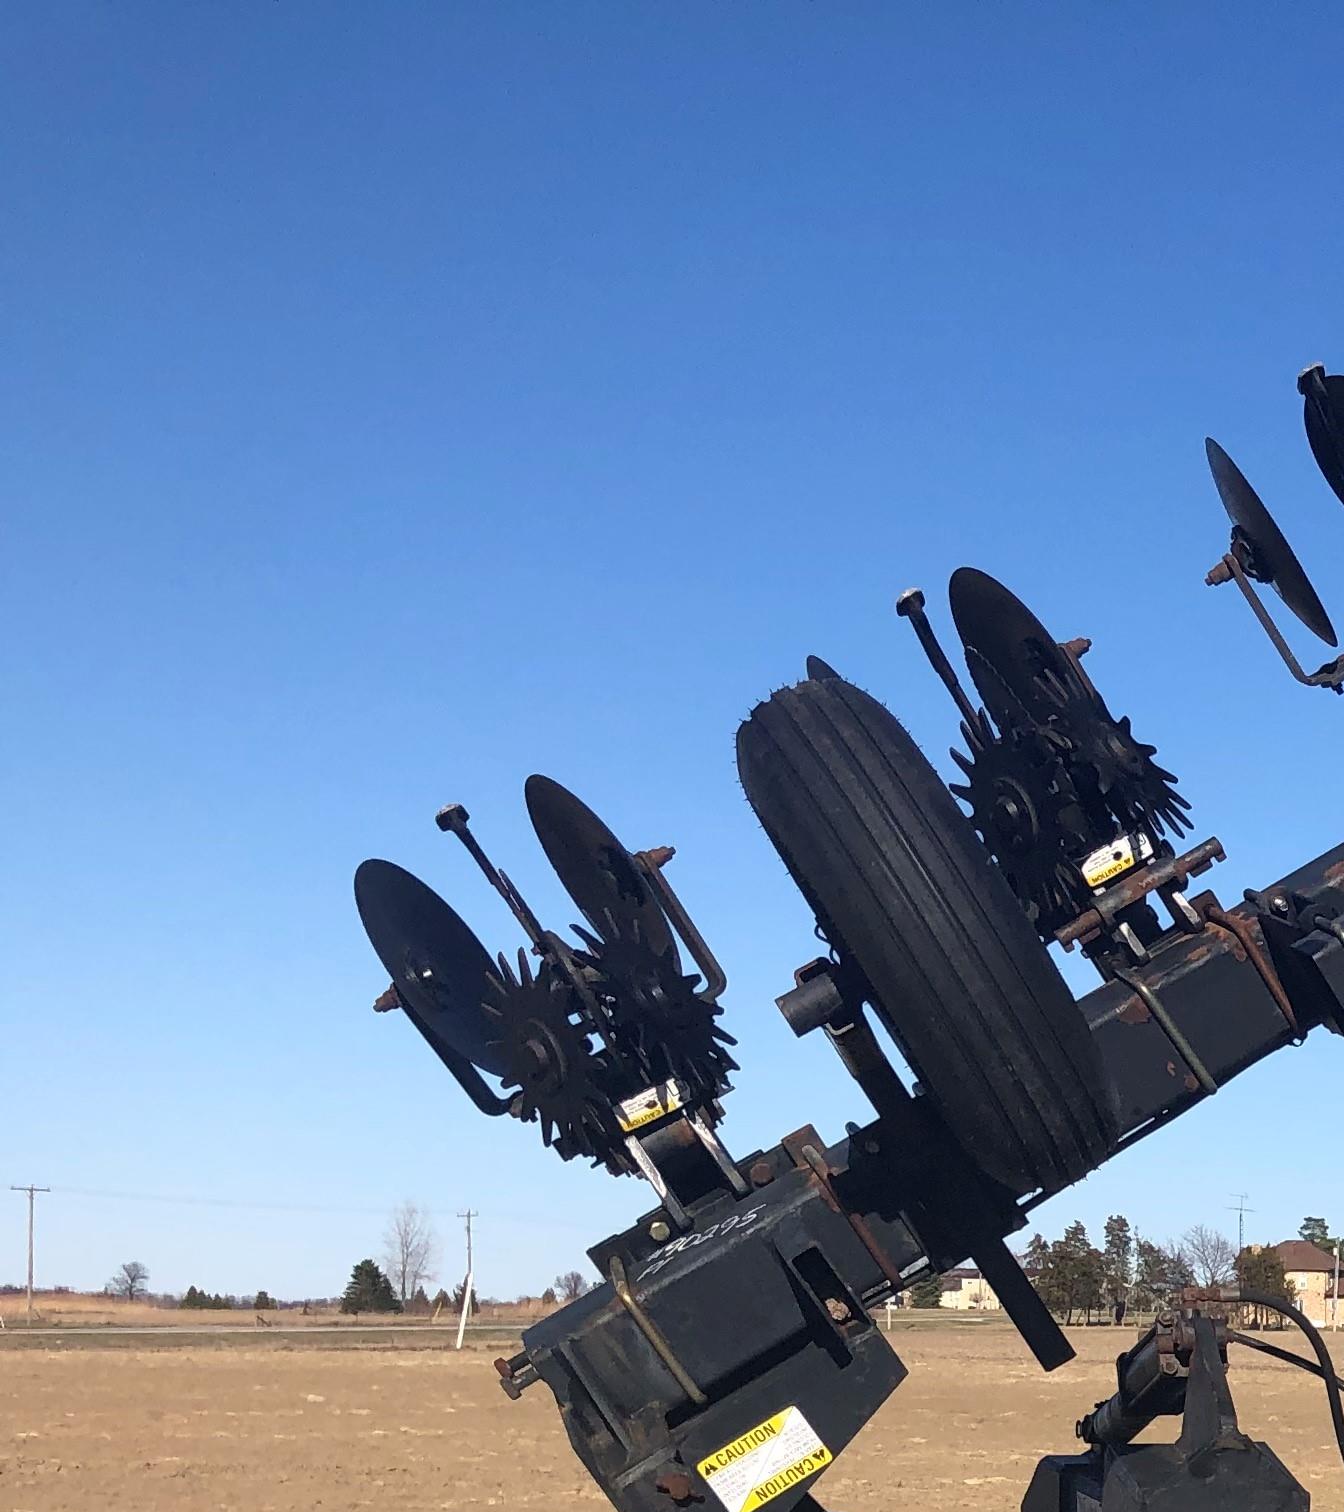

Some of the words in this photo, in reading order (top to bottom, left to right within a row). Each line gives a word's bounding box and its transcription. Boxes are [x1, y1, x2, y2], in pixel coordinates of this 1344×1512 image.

[1091, 864, 1123, 883] CAUTION
[715, 1422, 777, 1467] CAUTION
[754, 1457, 816, 1502] CAUTION
